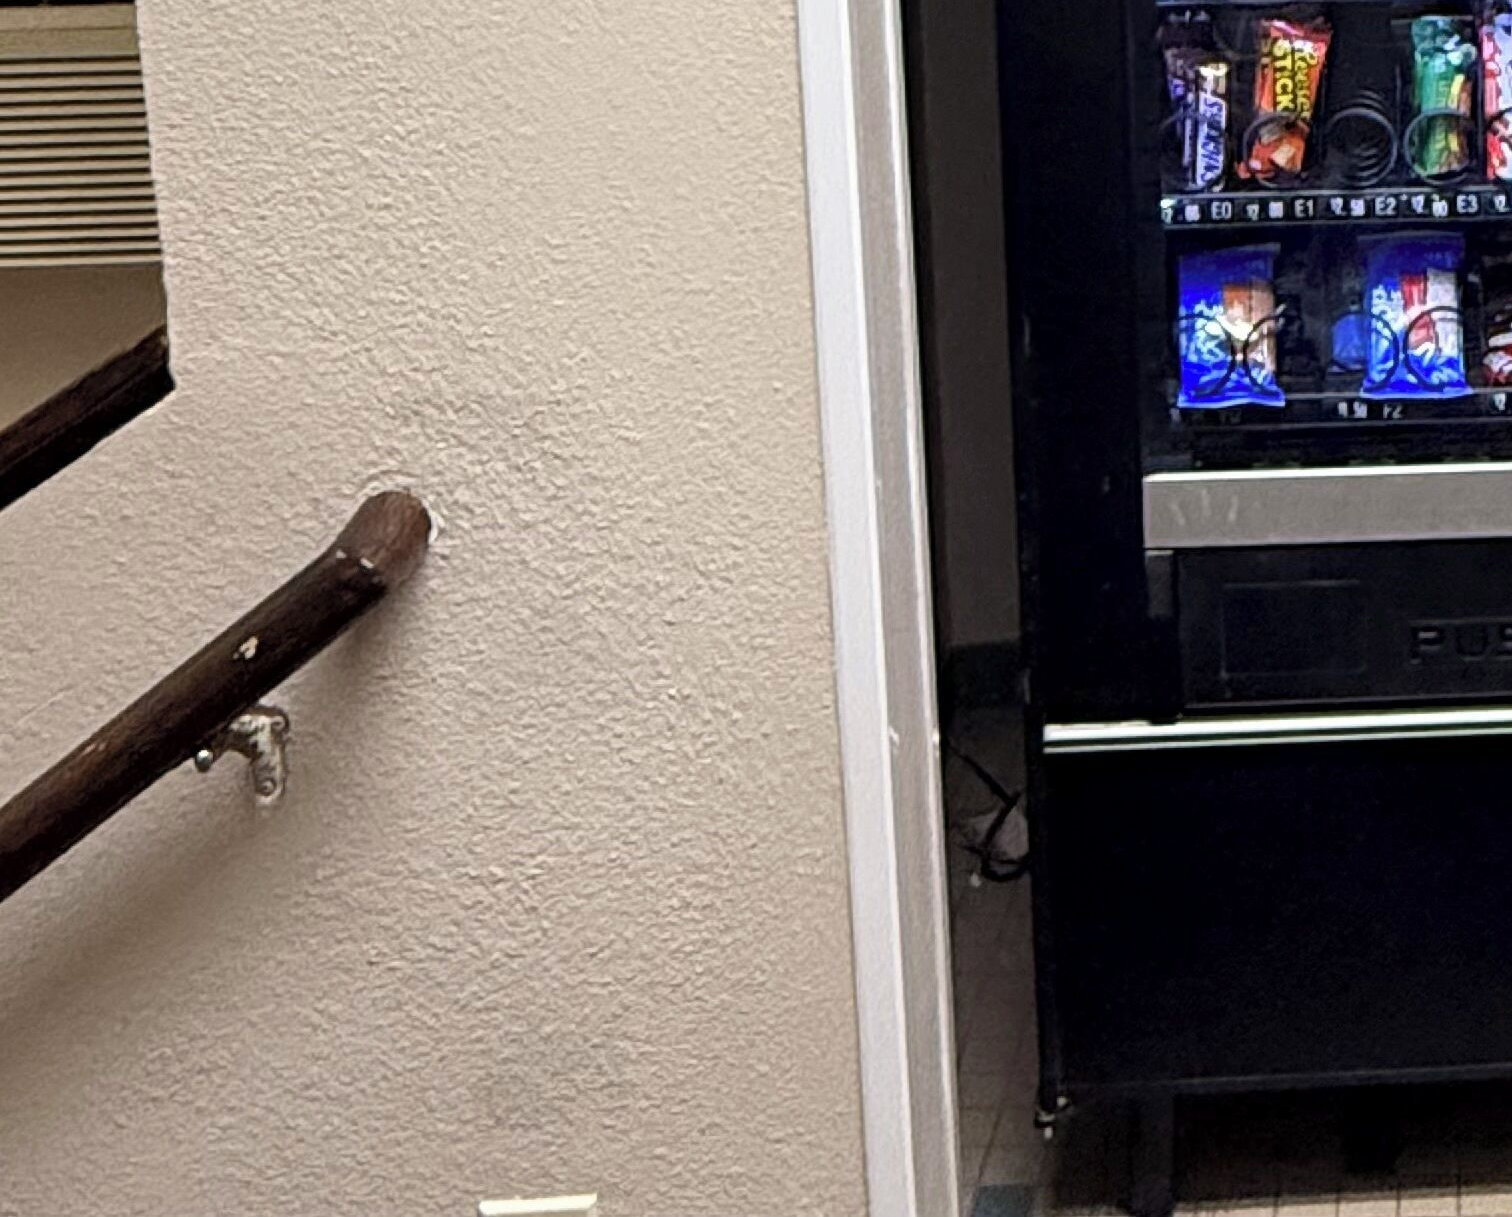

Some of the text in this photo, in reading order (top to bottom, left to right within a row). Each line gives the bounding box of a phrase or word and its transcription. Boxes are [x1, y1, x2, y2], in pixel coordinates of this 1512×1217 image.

[1211, 201, 1232, 220] E0
[1294, 198, 1314, 218] E1
[1374, 197, 1397, 216] E2
[1456, 194, 1478, 213] E3
